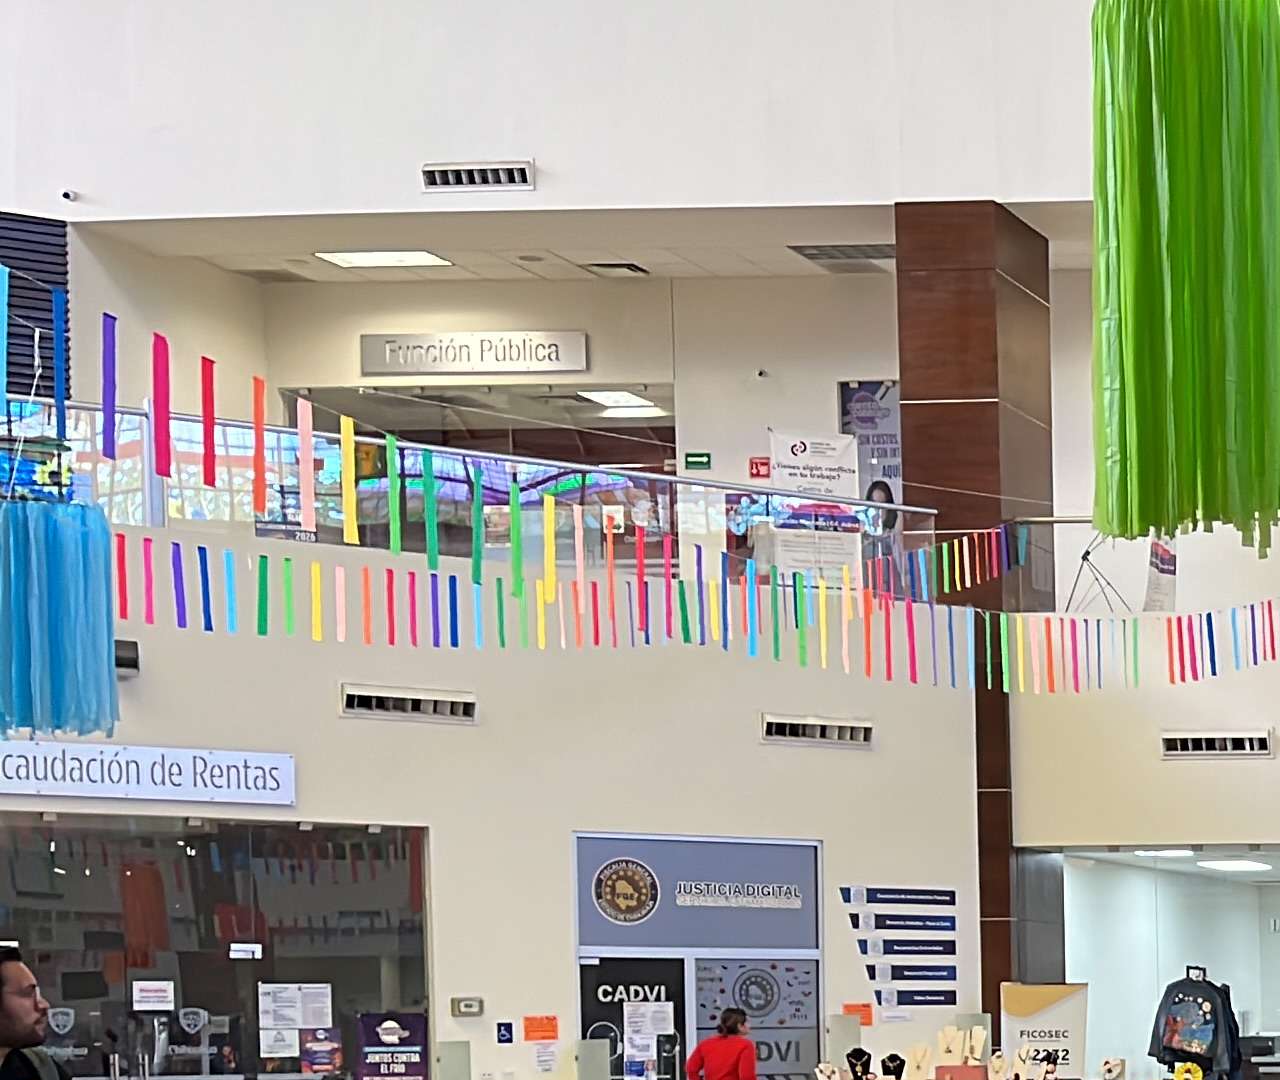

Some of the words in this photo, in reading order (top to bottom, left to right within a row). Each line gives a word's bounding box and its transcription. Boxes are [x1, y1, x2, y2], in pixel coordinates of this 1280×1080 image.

[384, 338, 471, 364] Función
[479, 337, 561, 362] Pública
[1, 749, 141, 785] caudación
[150, 754, 183, 787] de
[192, 755, 281, 791] Rentas
[677, 882, 742, 896] JUSTICIA
[746, 884, 800, 897] DIGITAL
[597, 985, 666, 1002] CADVI
[1020, 1030, 1069, 1039] FICOSEC
